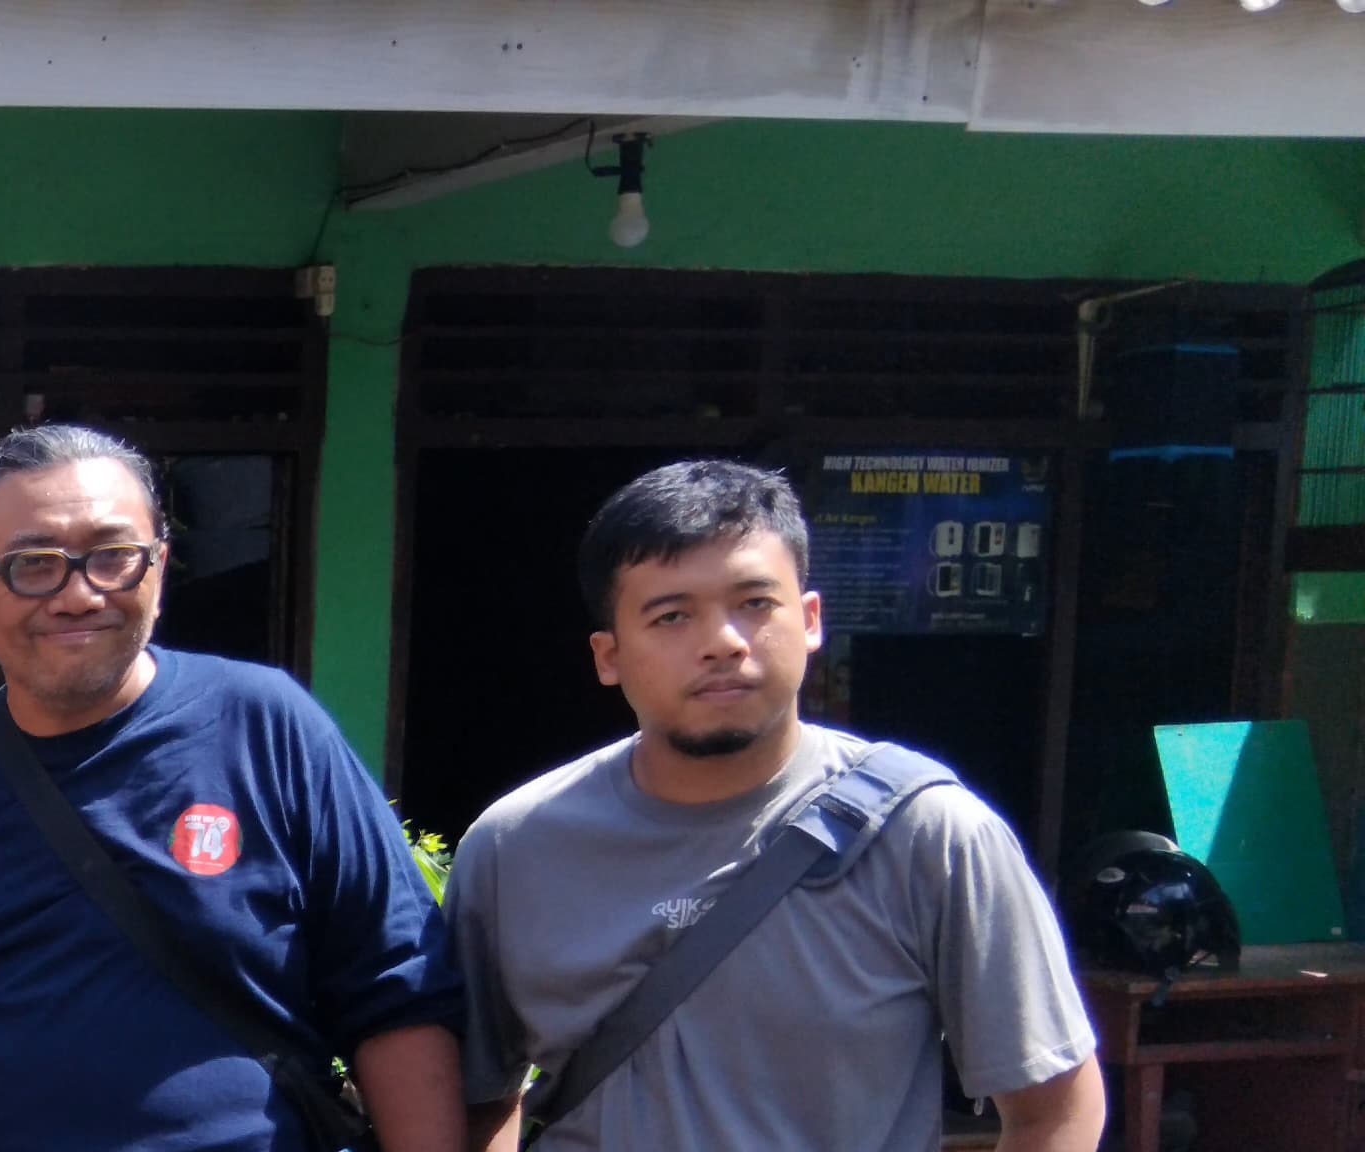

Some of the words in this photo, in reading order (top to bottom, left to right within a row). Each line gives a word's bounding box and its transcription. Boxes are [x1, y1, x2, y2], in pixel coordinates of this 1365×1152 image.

[823, 456, 853, 471] HIGH
[853, 456, 925, 471] TECHNOLOGY
[926, 456, 965, 472] WATER
[850, 472, 919, 493] KANGEN
[923, 472, 981, 494] WATER
